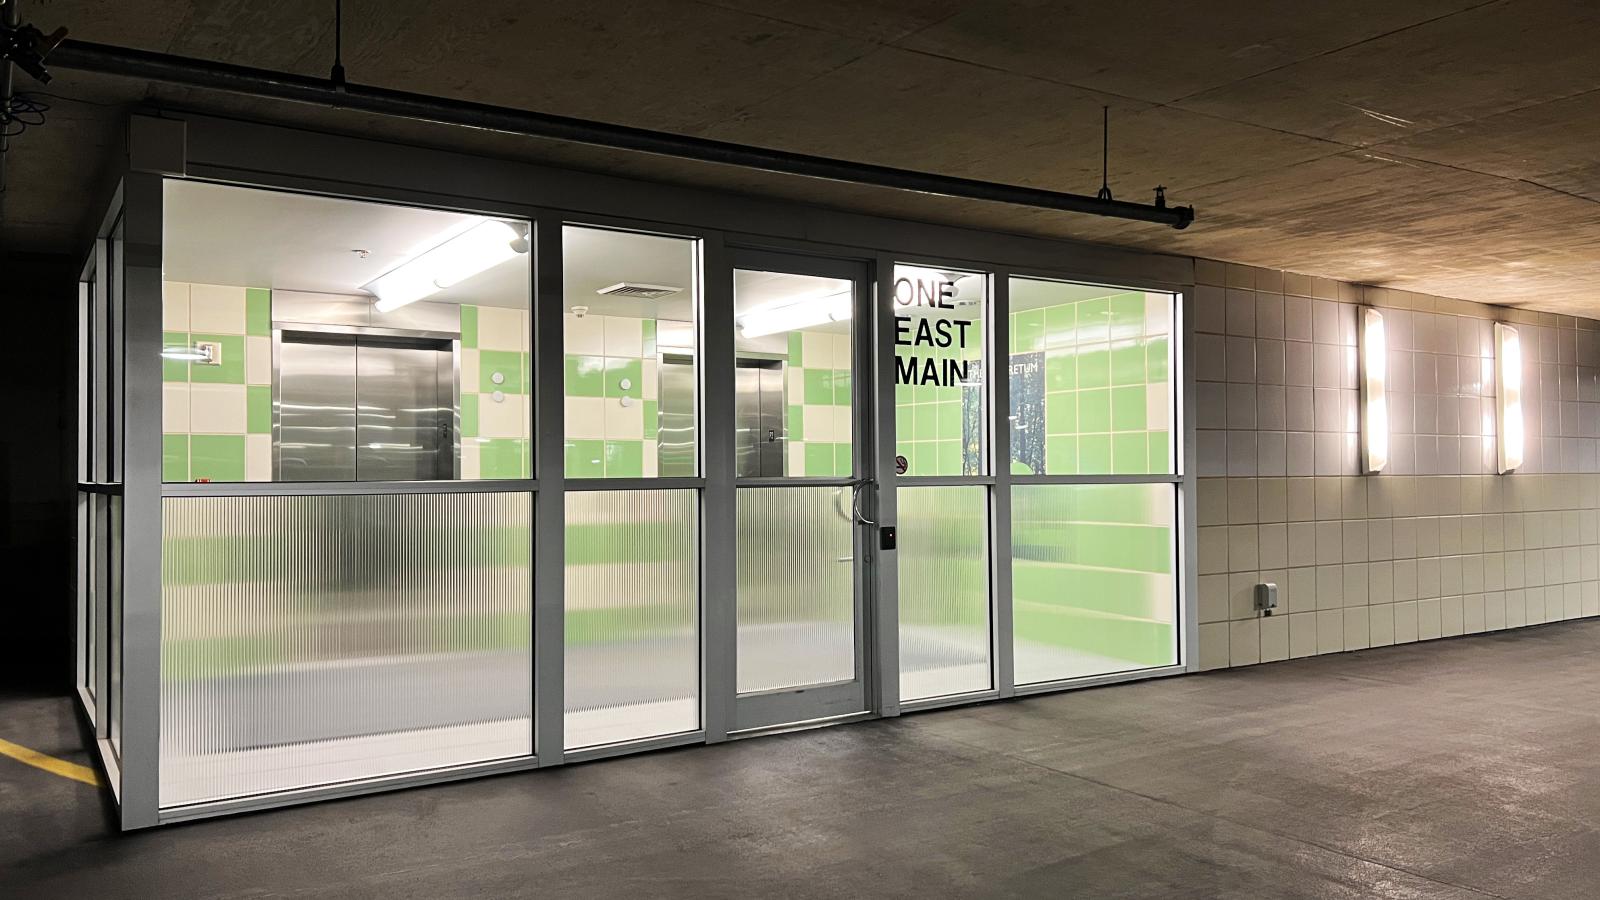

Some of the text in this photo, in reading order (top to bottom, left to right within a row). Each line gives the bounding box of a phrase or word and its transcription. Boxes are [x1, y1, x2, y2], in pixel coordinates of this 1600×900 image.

[895, 278, 954, 309] ONE
[895, 317, 971, 348] EAST
[895, 356, 968, 387] MAIN
